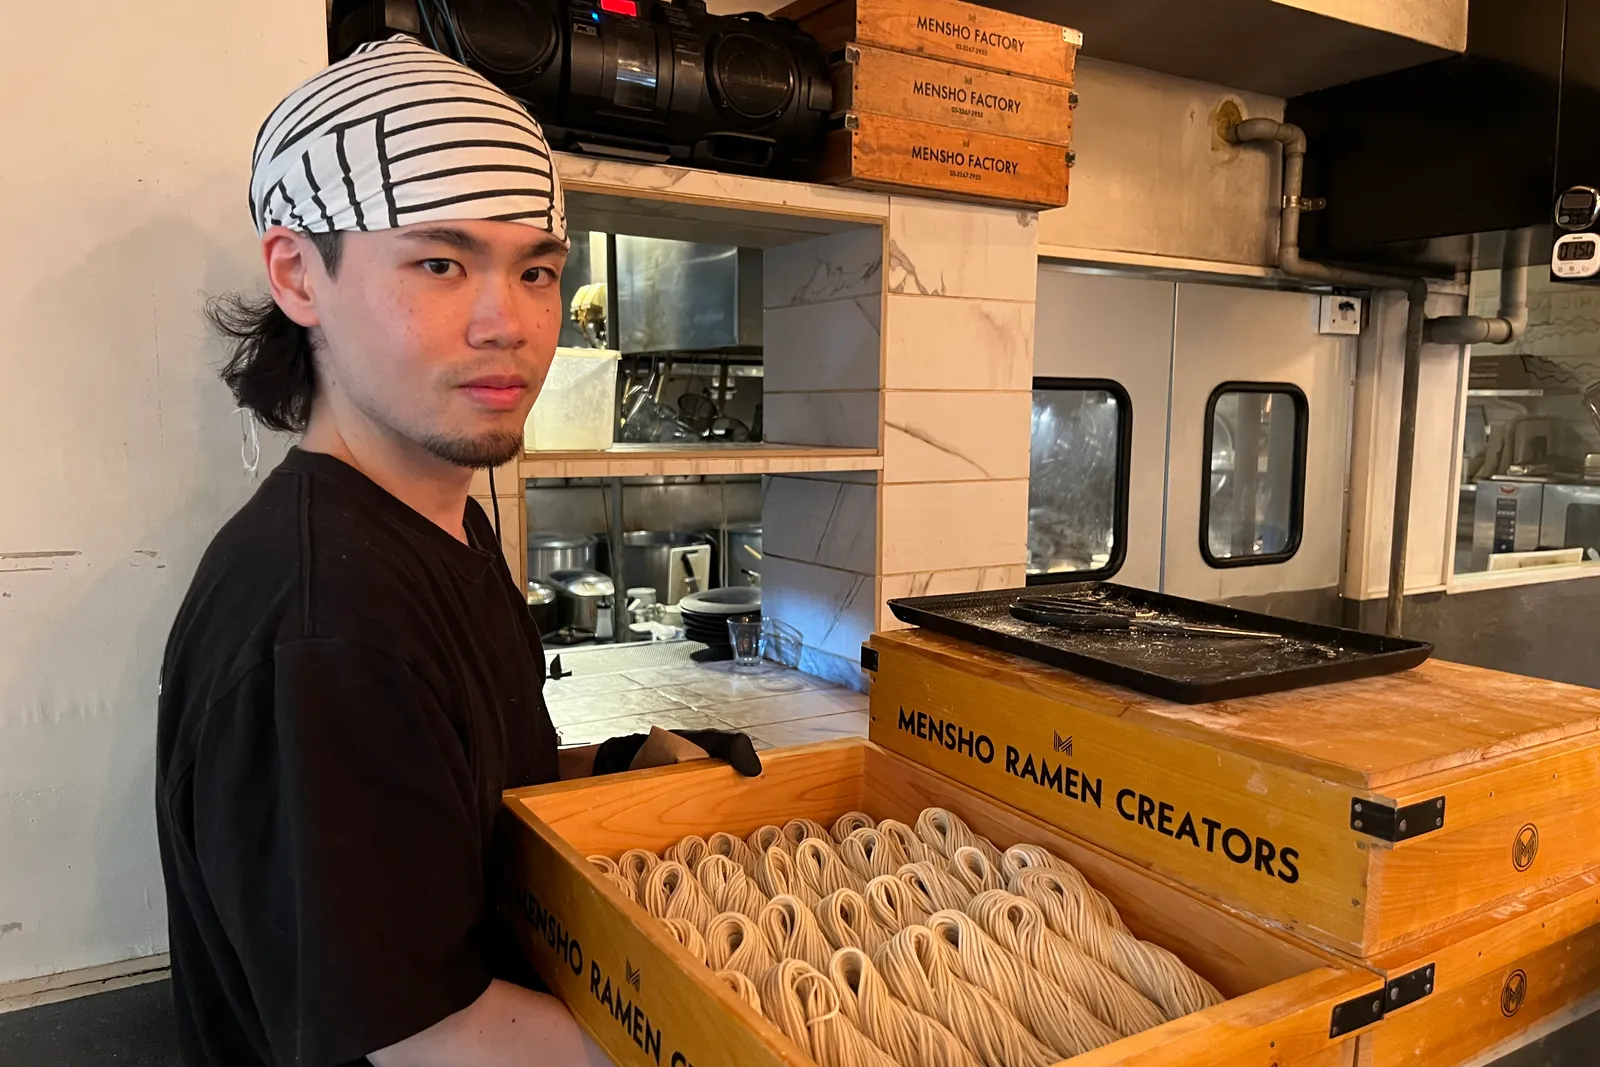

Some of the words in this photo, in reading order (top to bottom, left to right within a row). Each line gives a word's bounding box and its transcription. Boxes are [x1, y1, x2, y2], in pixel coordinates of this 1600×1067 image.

[916, 15, 971, 40] MENSHO
[974, 28, 1025, 53] FACTORY
[913, 80, 967, 103] MENSHO
[970, 91, 1021, 114] FACTORY
[911, 145, 965, 166] MENSHO
[968, 154, 1019, 175] FACTORY
[897, 704, 995, 764] MENSHO
[1005, 745, 1103, 809] RAMEN
[1115, 788, 1300, 884] CREATORS
[515, 887, 584, 976] MENSHO
[590, 959, 662, 1067] RAMEN
